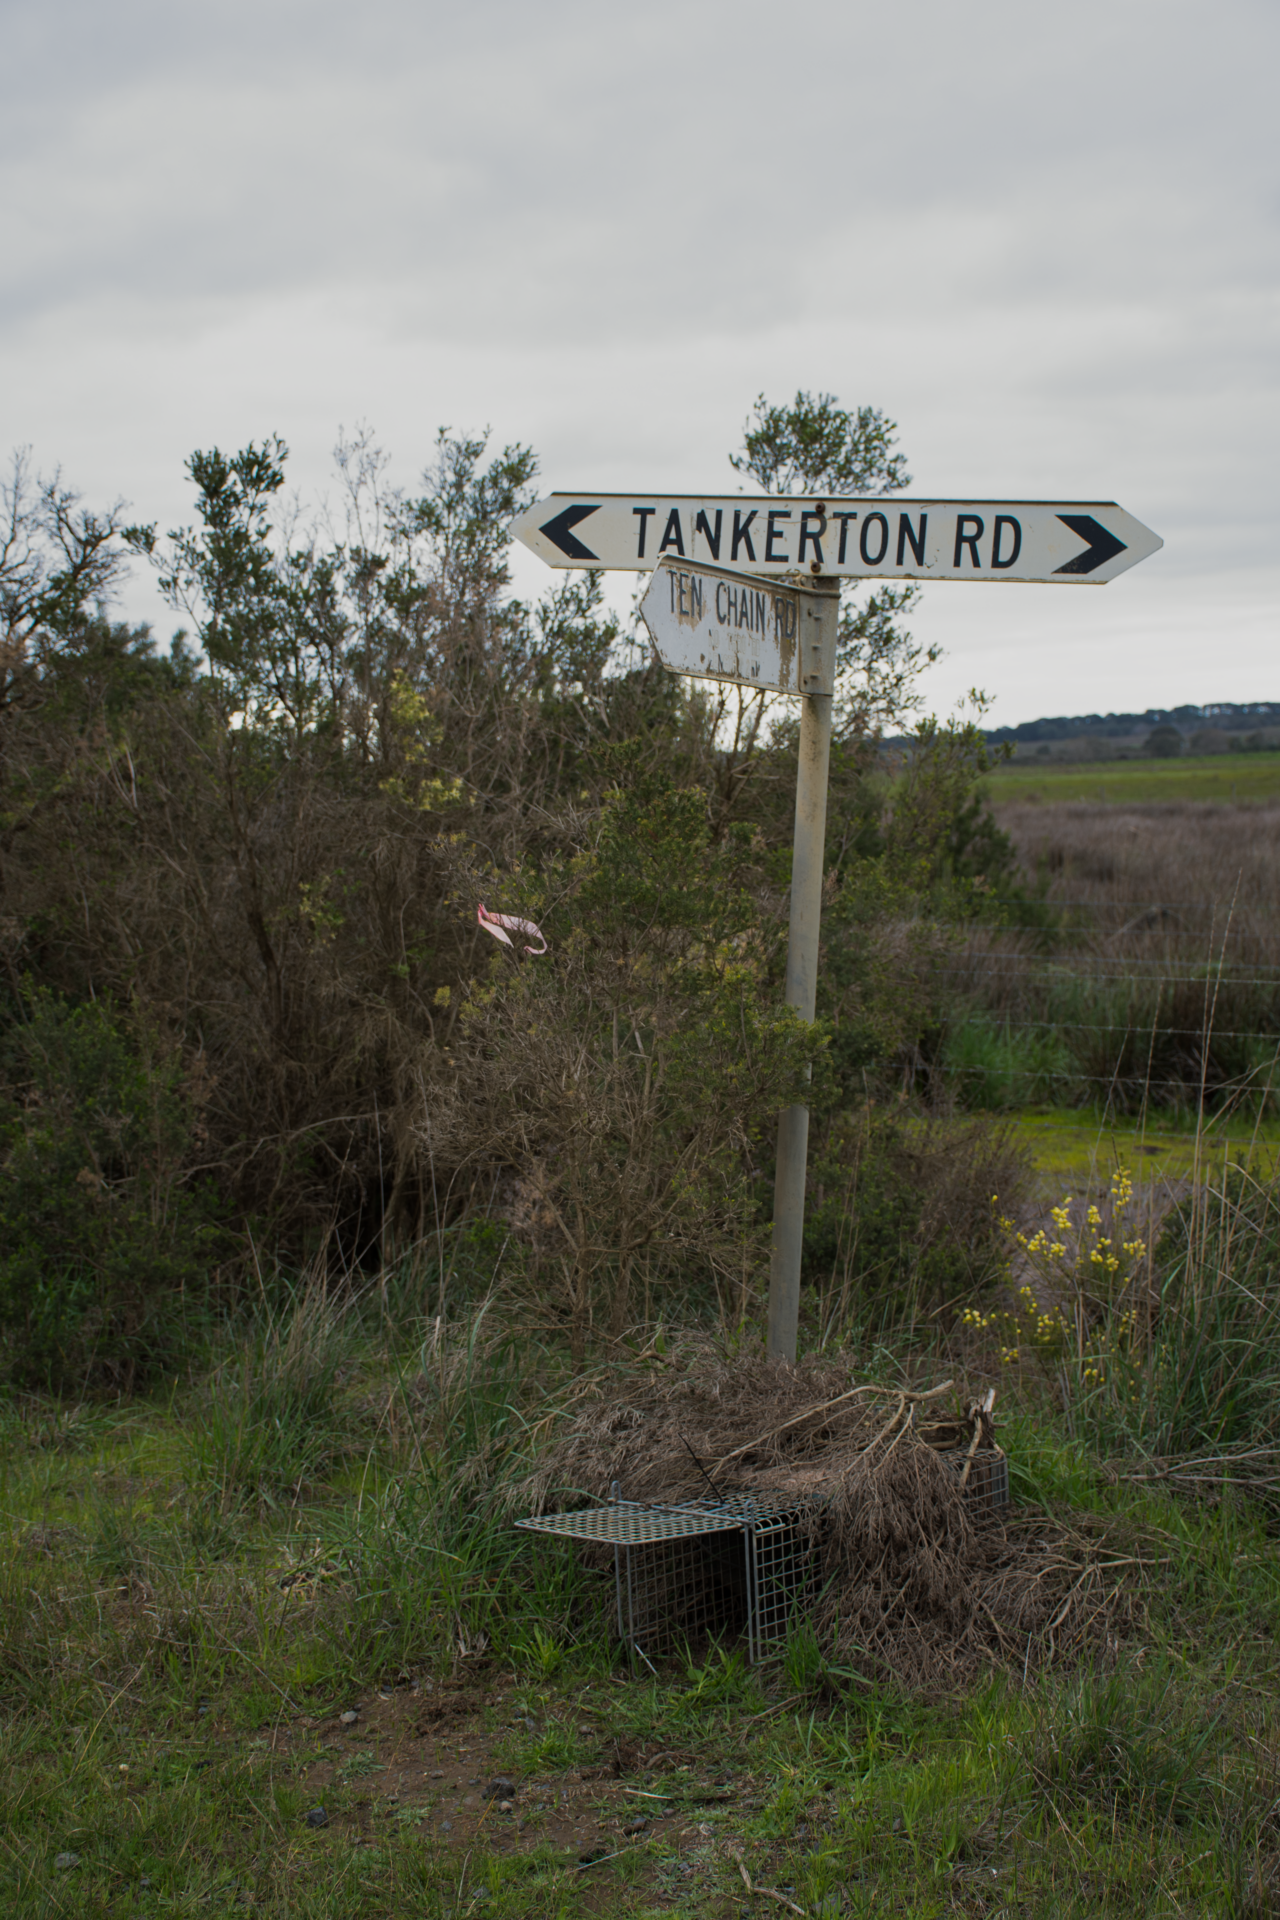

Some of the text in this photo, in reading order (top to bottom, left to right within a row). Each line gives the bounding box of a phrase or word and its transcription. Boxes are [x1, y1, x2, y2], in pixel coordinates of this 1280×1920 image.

[633, 507, 1022, 569] TANKERTON RD
[667, 570, 797, 639] TEN CHAIN RD
